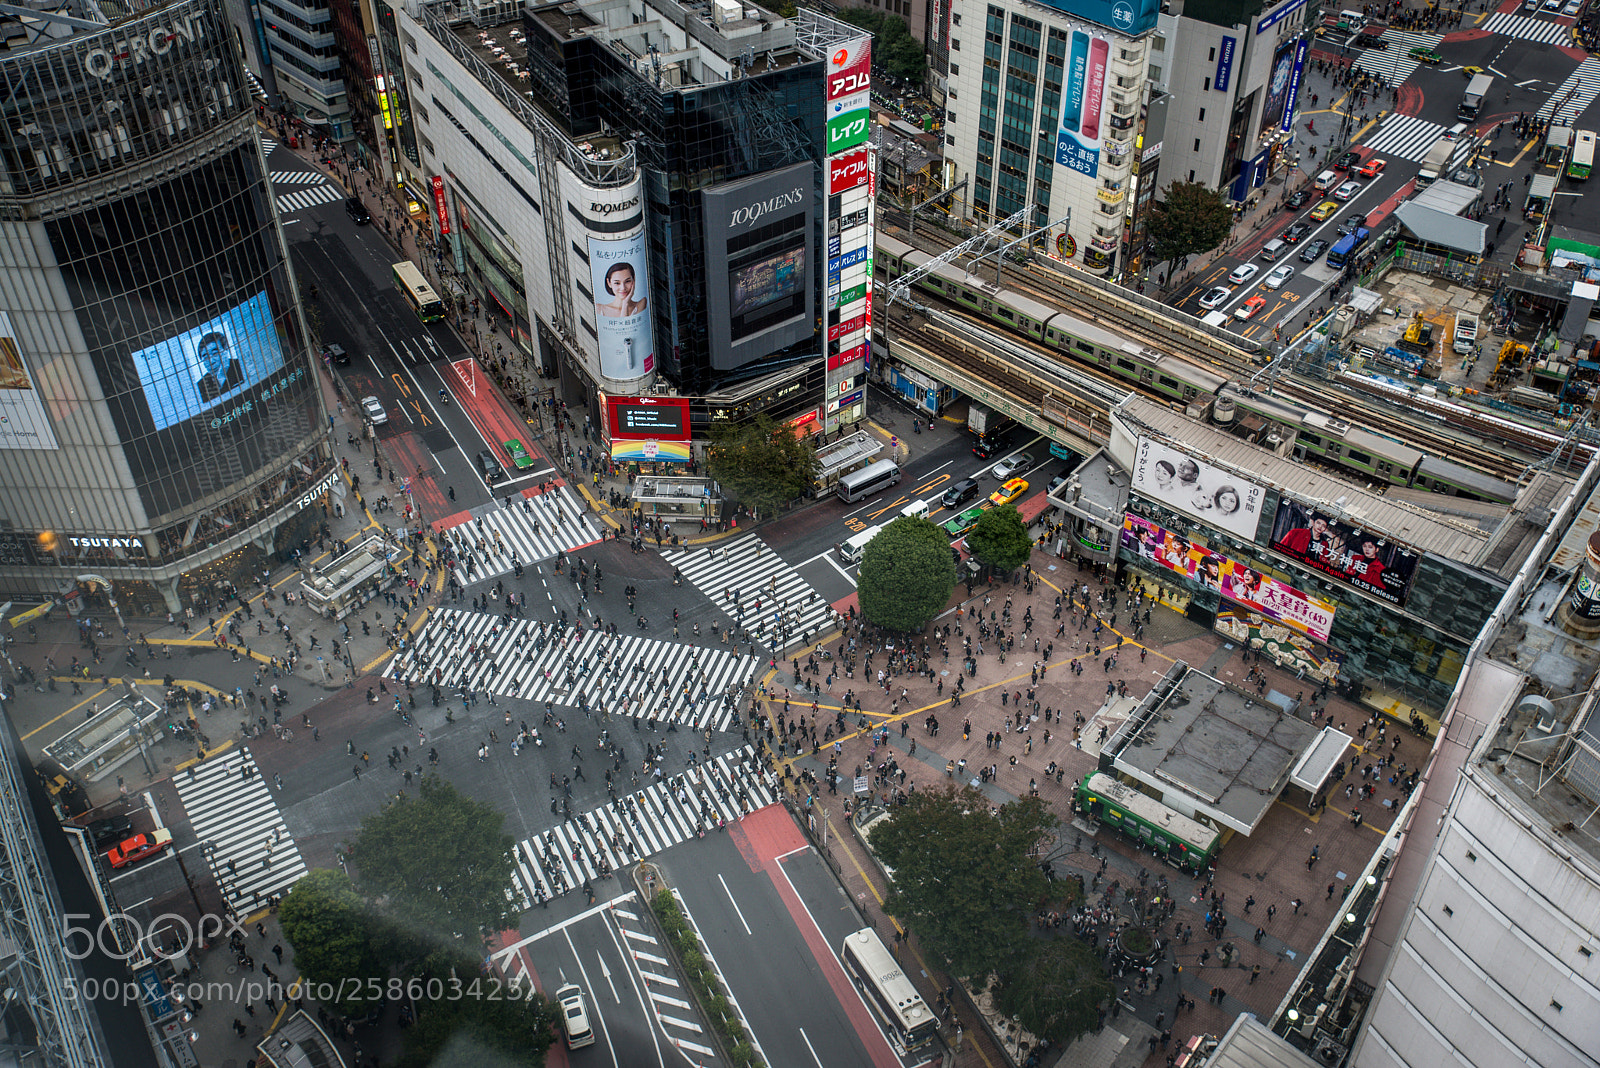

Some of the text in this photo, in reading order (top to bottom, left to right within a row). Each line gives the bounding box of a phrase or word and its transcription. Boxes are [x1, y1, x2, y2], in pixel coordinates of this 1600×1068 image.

[1113, 7, 1133, 24] 生薬
[831, 71, 870, 96] アコム
[831, 117, 866, 143] レイク
[831, 160, 867, 182] アイフル
[1061, 155, 1091, 174] うるおう
[595, 243, 643, 260] 私をリフトする
[840, 290, 856, 303] レイク
[830, 321, 855, 338] アコム
[296, 472, 339, 510] TSUTAYA
[1131, 503, 1152, 517] JR
[844, 517, 867, 532] 8-20
[69, 537, 142, 548] TSUTAYA
[1310, 540, 1369, 575] 東方神起
[1351, 577, 1370, 591] 10.25
[1370, 586, 1399, 603] Release
